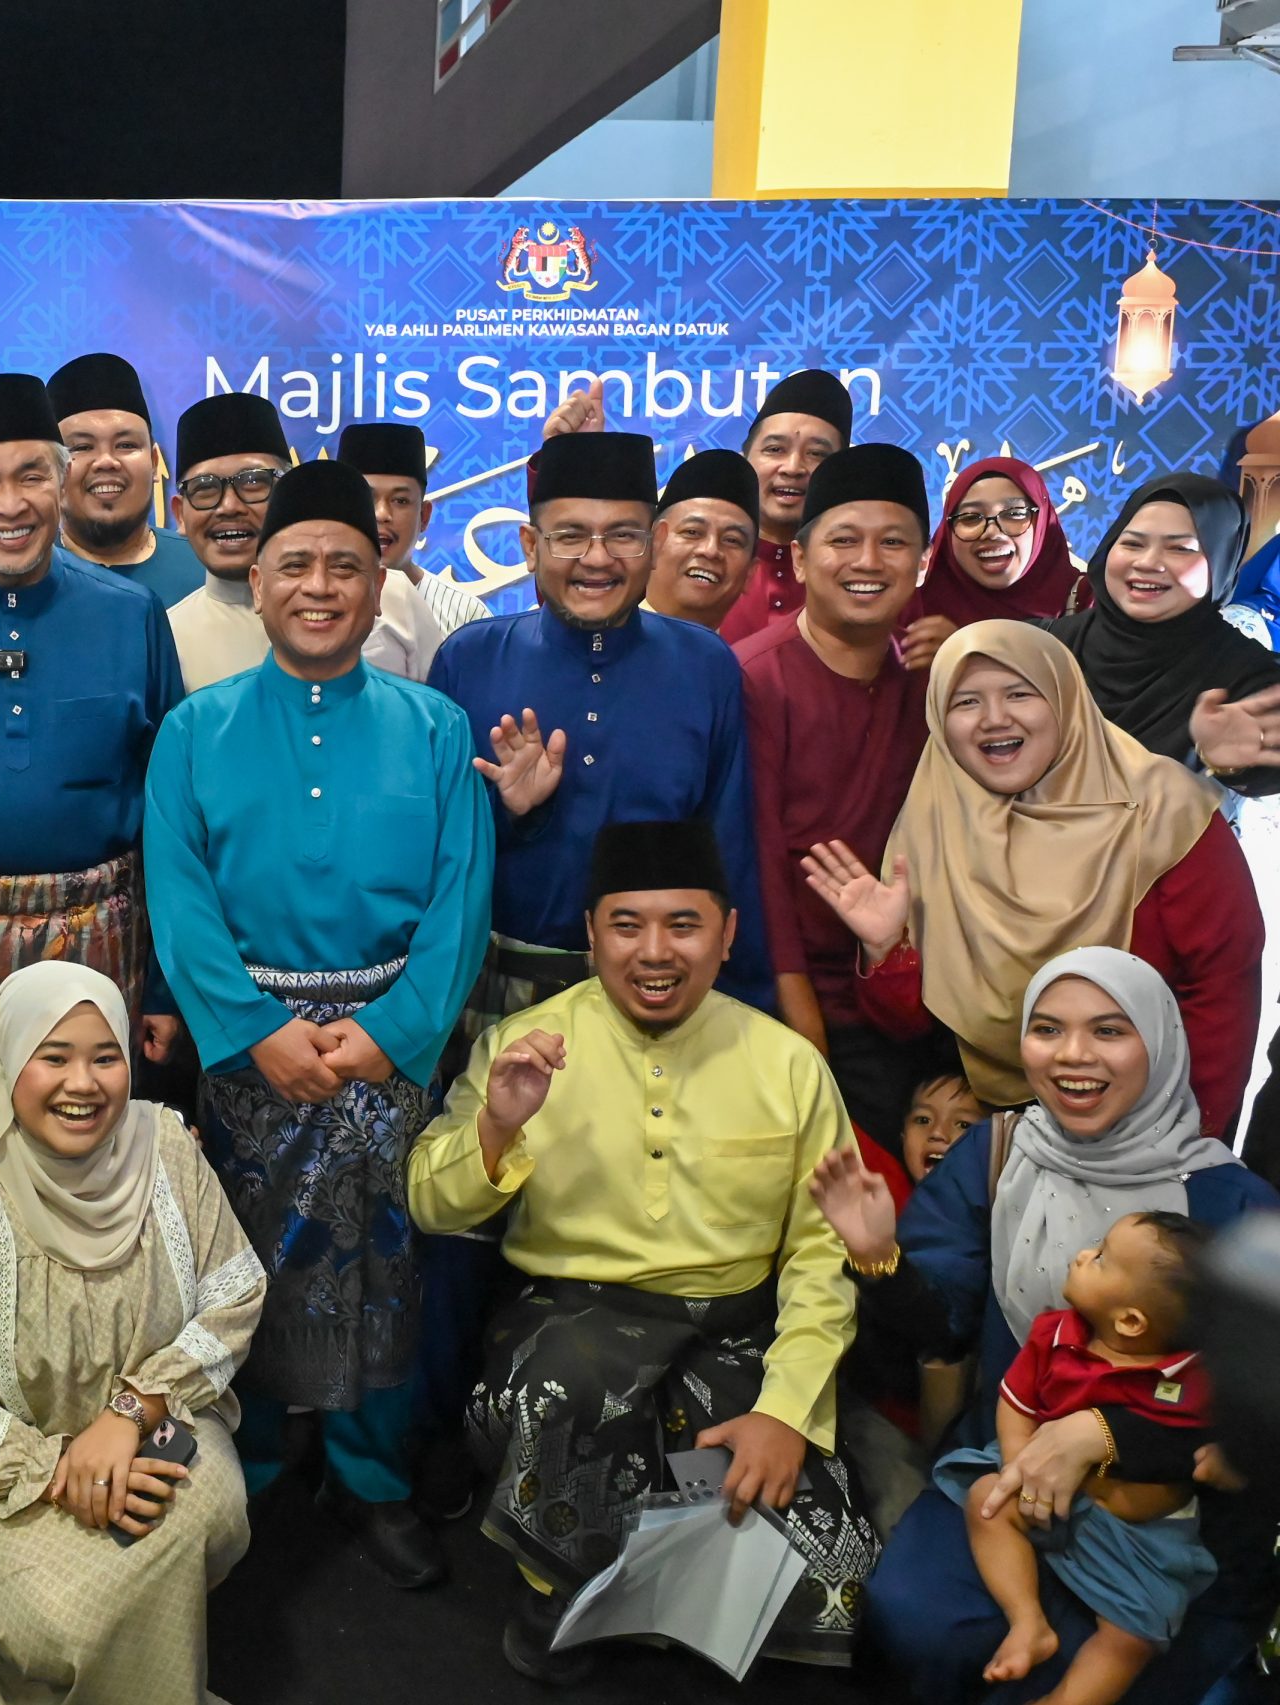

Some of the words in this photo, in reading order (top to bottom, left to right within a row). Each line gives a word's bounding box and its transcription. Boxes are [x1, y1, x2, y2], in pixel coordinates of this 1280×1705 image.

[455, 308, 508, 321] PUSAT
[511, 308, 639, 321] PERKHIDMATAN
[365, 324, 397, 337] YAB
[400, 324, 438, 337] AHLI
[442, 323, 524, 337] PARLIMEN
[527, 323, 610, 336] KAWASAN
[613, 323, 670, 336] BAGAN
[673, 322, 729, 336] DATUK
[205, 352, 431, 435] Majlis
[455, 351, 881, 419] Sambutn
